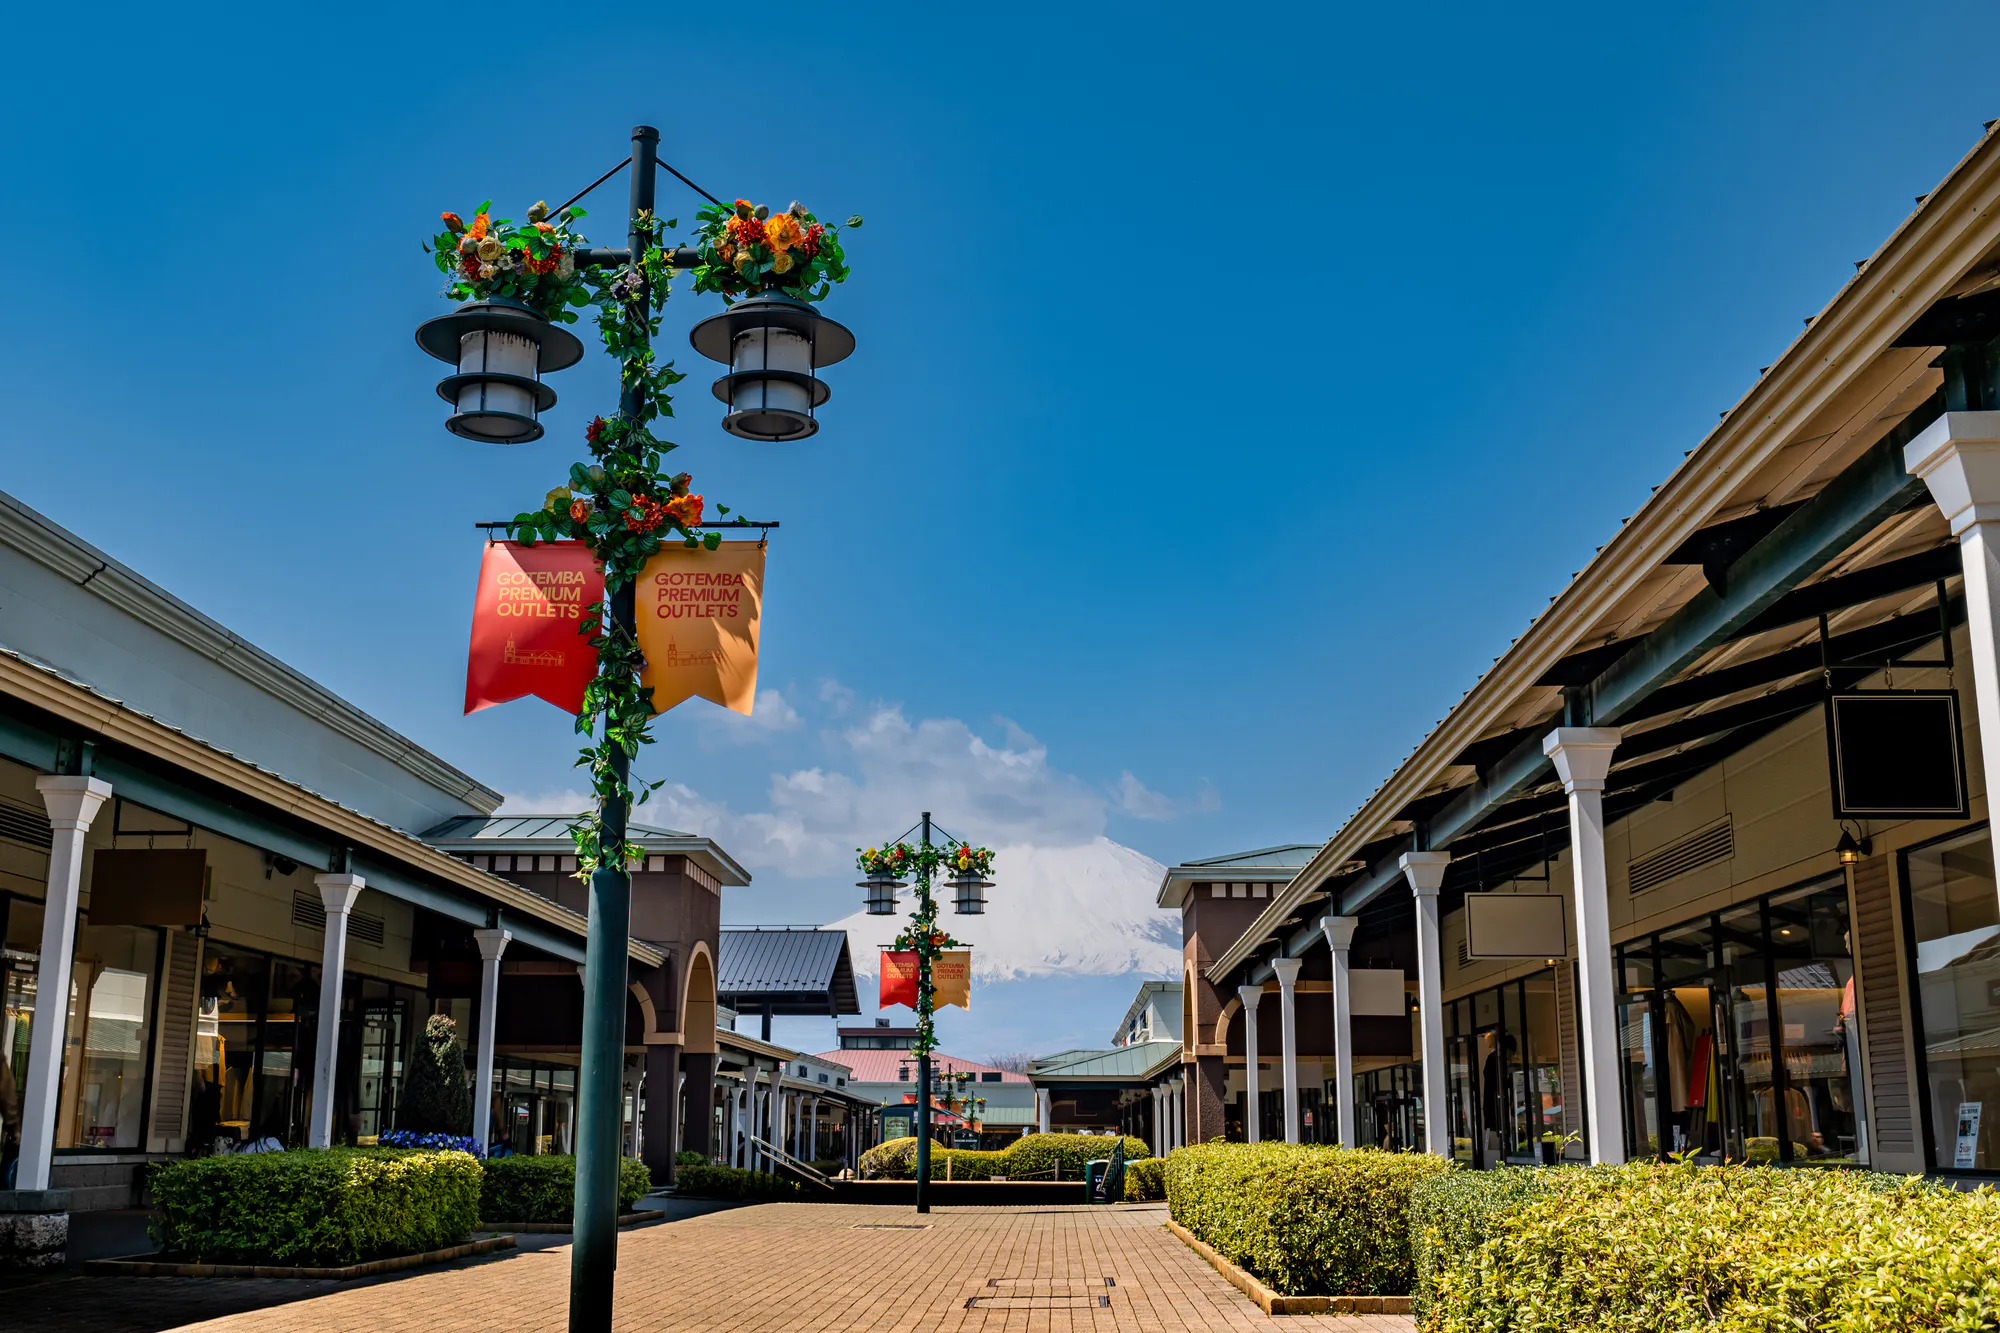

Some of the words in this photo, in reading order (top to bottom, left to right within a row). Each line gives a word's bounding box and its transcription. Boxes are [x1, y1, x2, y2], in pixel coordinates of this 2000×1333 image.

[497, 571, 586, 585] GOTEMBA
[655, 572, 745, 586] GOTEMBA
[499, 587, 581, 601] PREMIUM
[658, 588, 739, 602] PREMIUM
[497, 602, 580, 619] OUTLETS
[657, 604, 738, 619] OUTLETS
